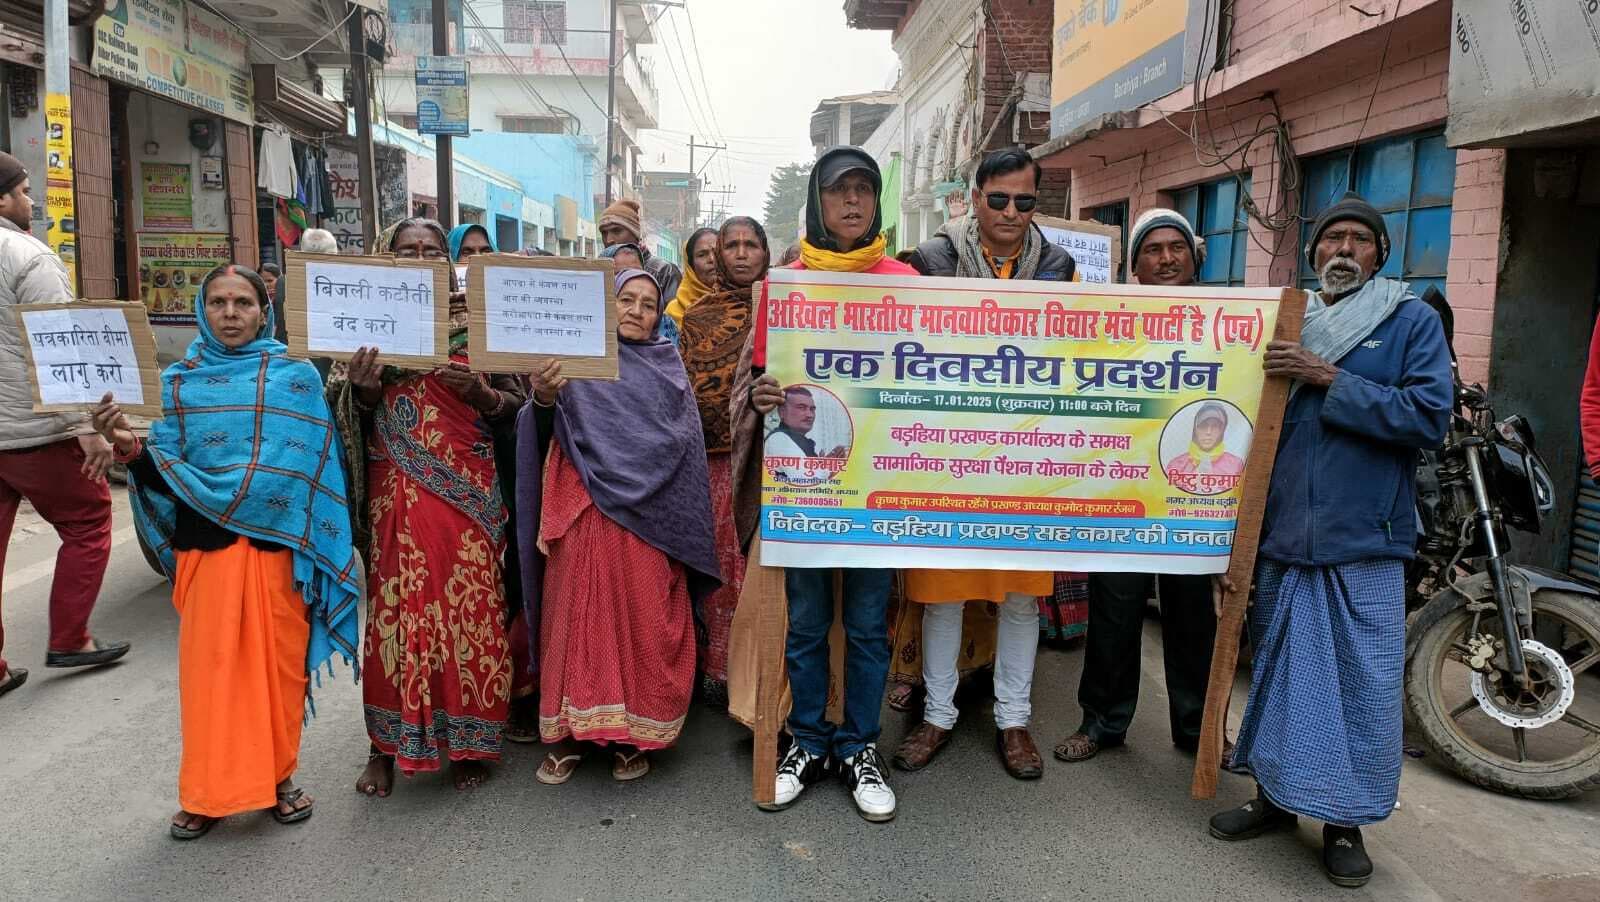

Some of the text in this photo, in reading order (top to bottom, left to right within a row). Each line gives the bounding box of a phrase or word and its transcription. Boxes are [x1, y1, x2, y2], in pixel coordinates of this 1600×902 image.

[1143, 57, 1167, 84] Branch
[146, 76, 225, 115] COMPETITIVE CLASSES
[314, 275, 373, 300] बिजली
[378, 281, 432, 305] कटौती
[32, 324, 100, 347] पत्रकारिता
[332, 312, 398, 335] बंद करो
[768, 292, 1264, 352] अखिल भारतीय मानवाधिकार विचार मंच पार्टी है (एच)
[1361, 340, 1384, 349] 4F
[95, 356, 123, 384] करो
[803, 341, 1224, 391] एक दिवसीय प्रदर्शन
[934, 394, 992, 407] 17.01.2025
[995, 395, 1055, 413] (शुक्रवार)
[1060, 400, 1087, 411] 11:00
[1090, 400, 1113, 413] बजे
[1115, 400, 1142, 413] दिन
[891, 423, 1132, 450] बड़हिया प्रखण्ड कार्यालय के समक्ष
[765, 456, 848, 477] कृष्ण कुमार
[873, 452, 946, 471] सामाजिक
[949, 459, 992, 479] सुरक्षा
[1036, 458, 1087, 478] योजना
[1088, 460, 1107, 479] के
[1109, 461, 1152, 480] लेकर
[875, 496, 898, 508] कृष्ण
[900, 497, 928, 509] कुमार
[928, 496, 966, 509] उपस्थित
[991, 499, 1022, 511] प्रखण्ड
[1022, 502, 1052, 512] अध्यक्ष
[1085, 504, 1113, 516] कुमार
[1113, 501, 1137, 514] रंजन
[871, 515, 954, 541] बड़हिया
[958, 521, 1033, 541] प्रखण्ड
[1033, 525, 1074, 542] सह
[1075, 526, 1133, 544] नगर
[1135, 523, 1169, 545] की
[1172, 529, 1235, 547] जनता
